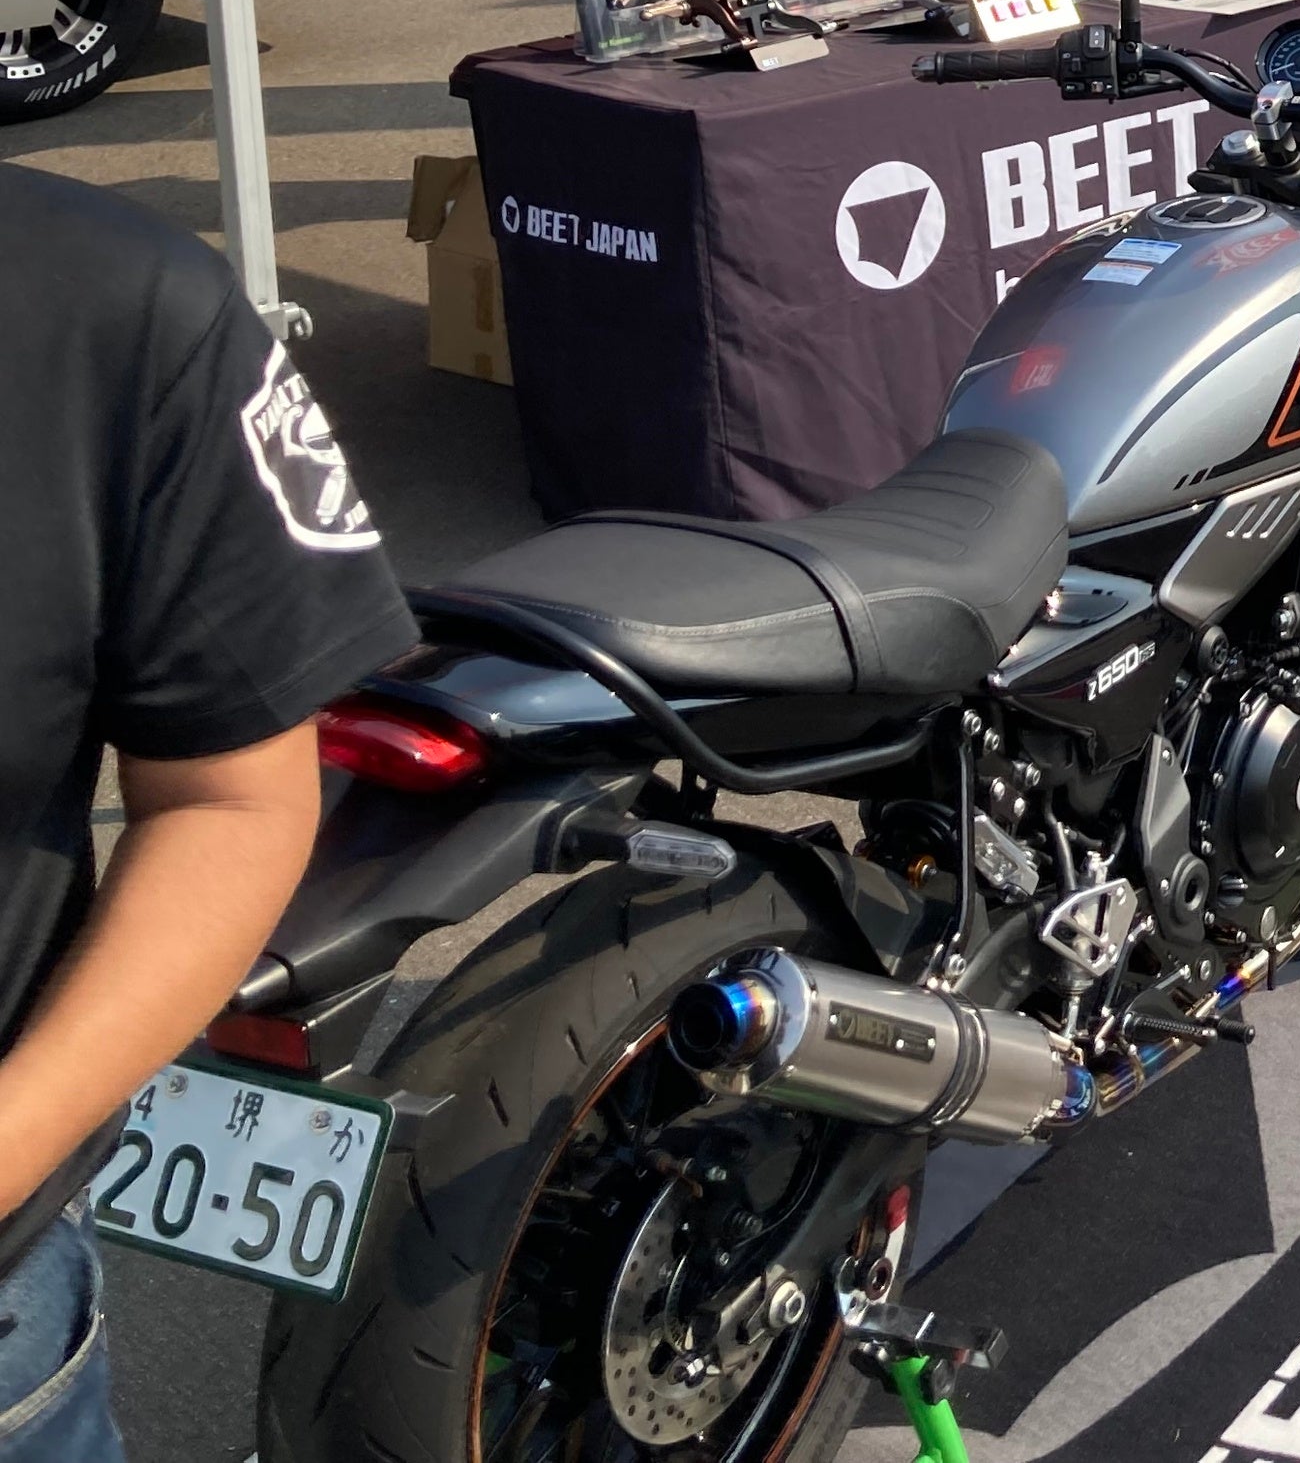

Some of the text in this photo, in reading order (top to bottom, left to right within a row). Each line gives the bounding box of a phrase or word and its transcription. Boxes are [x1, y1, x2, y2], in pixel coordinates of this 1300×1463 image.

[982, 98, 1211, 250] BEET
[526, 204, 659, 263] BEET JAPAN
[225, 1089, 265, 1142] 堺
[329, 1117, 365, 1164] か
[94, 1129, 346, 1278] 20-50
